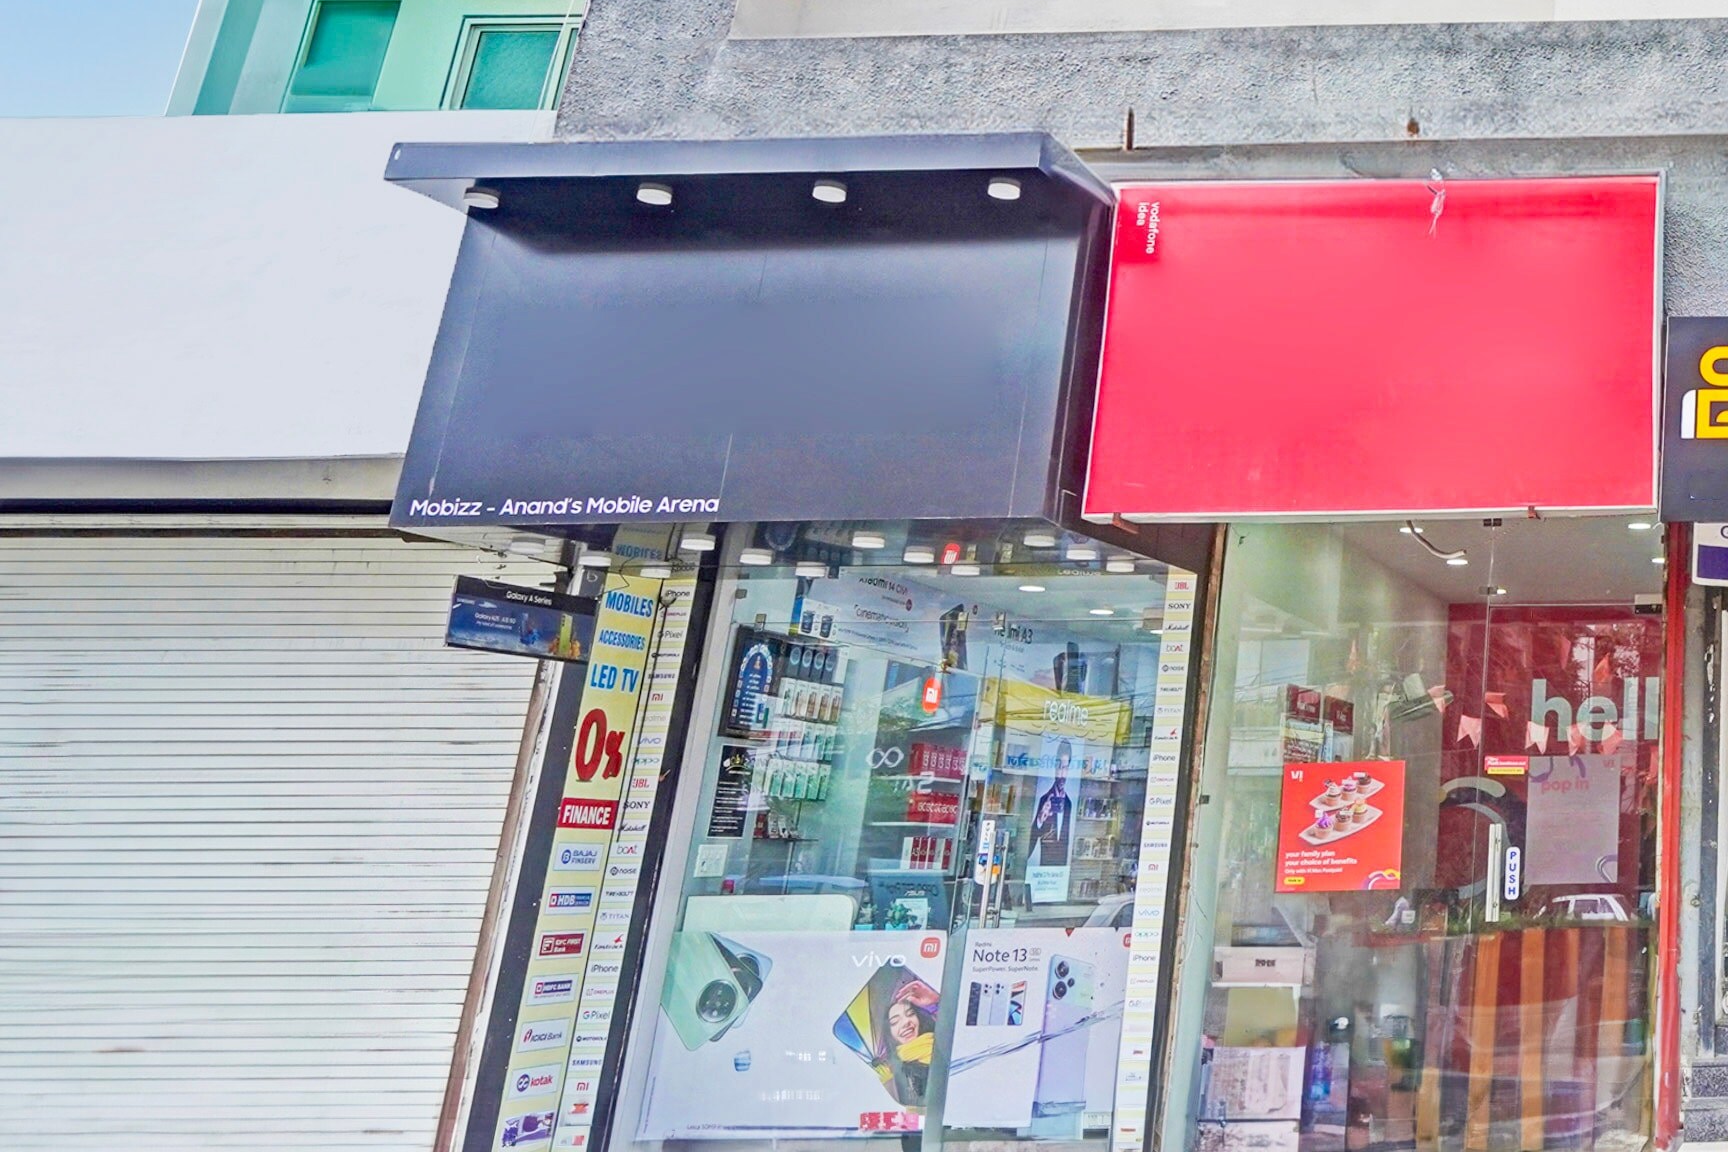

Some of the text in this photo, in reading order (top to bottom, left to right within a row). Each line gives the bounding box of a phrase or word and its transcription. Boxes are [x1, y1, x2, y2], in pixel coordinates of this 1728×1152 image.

[409, 499, 481, 516] Mobizz
[499, 498, 582, 516] Anand's
[586, 497, 652, 514] Mobile
[656, 497, 719, 513] Arena
[506, 590, 528, 605] Galaxy
[667, 589, 690, 597] iPhone
[605, 591, 654, 617] MOBILES
[598, 629, 646, 650] ACCESSORIES
[665, 631, 683, 639] Pixel
[590, 663, 640, 693] LED TV
[1044, 700, 1089, 726] realme
[1153, 754, 1176, 762] iPhone
[624, 801, 650, 809] SONY
[562, 805, 611, 825] FINANCE
[1286, 851, 1300, 859] your
[1331, 857, 1357, 865] benefits
[1509, 851, 1518, 895] PUSH
[852, 951, 906, 967] vivo
[973, 948, 1027, 962] Note 13
[1132, 954, 1156, 962] iPhone
[591, 964, 619, 973] iPhone
[530, 1075, 553, 1087] kotak
